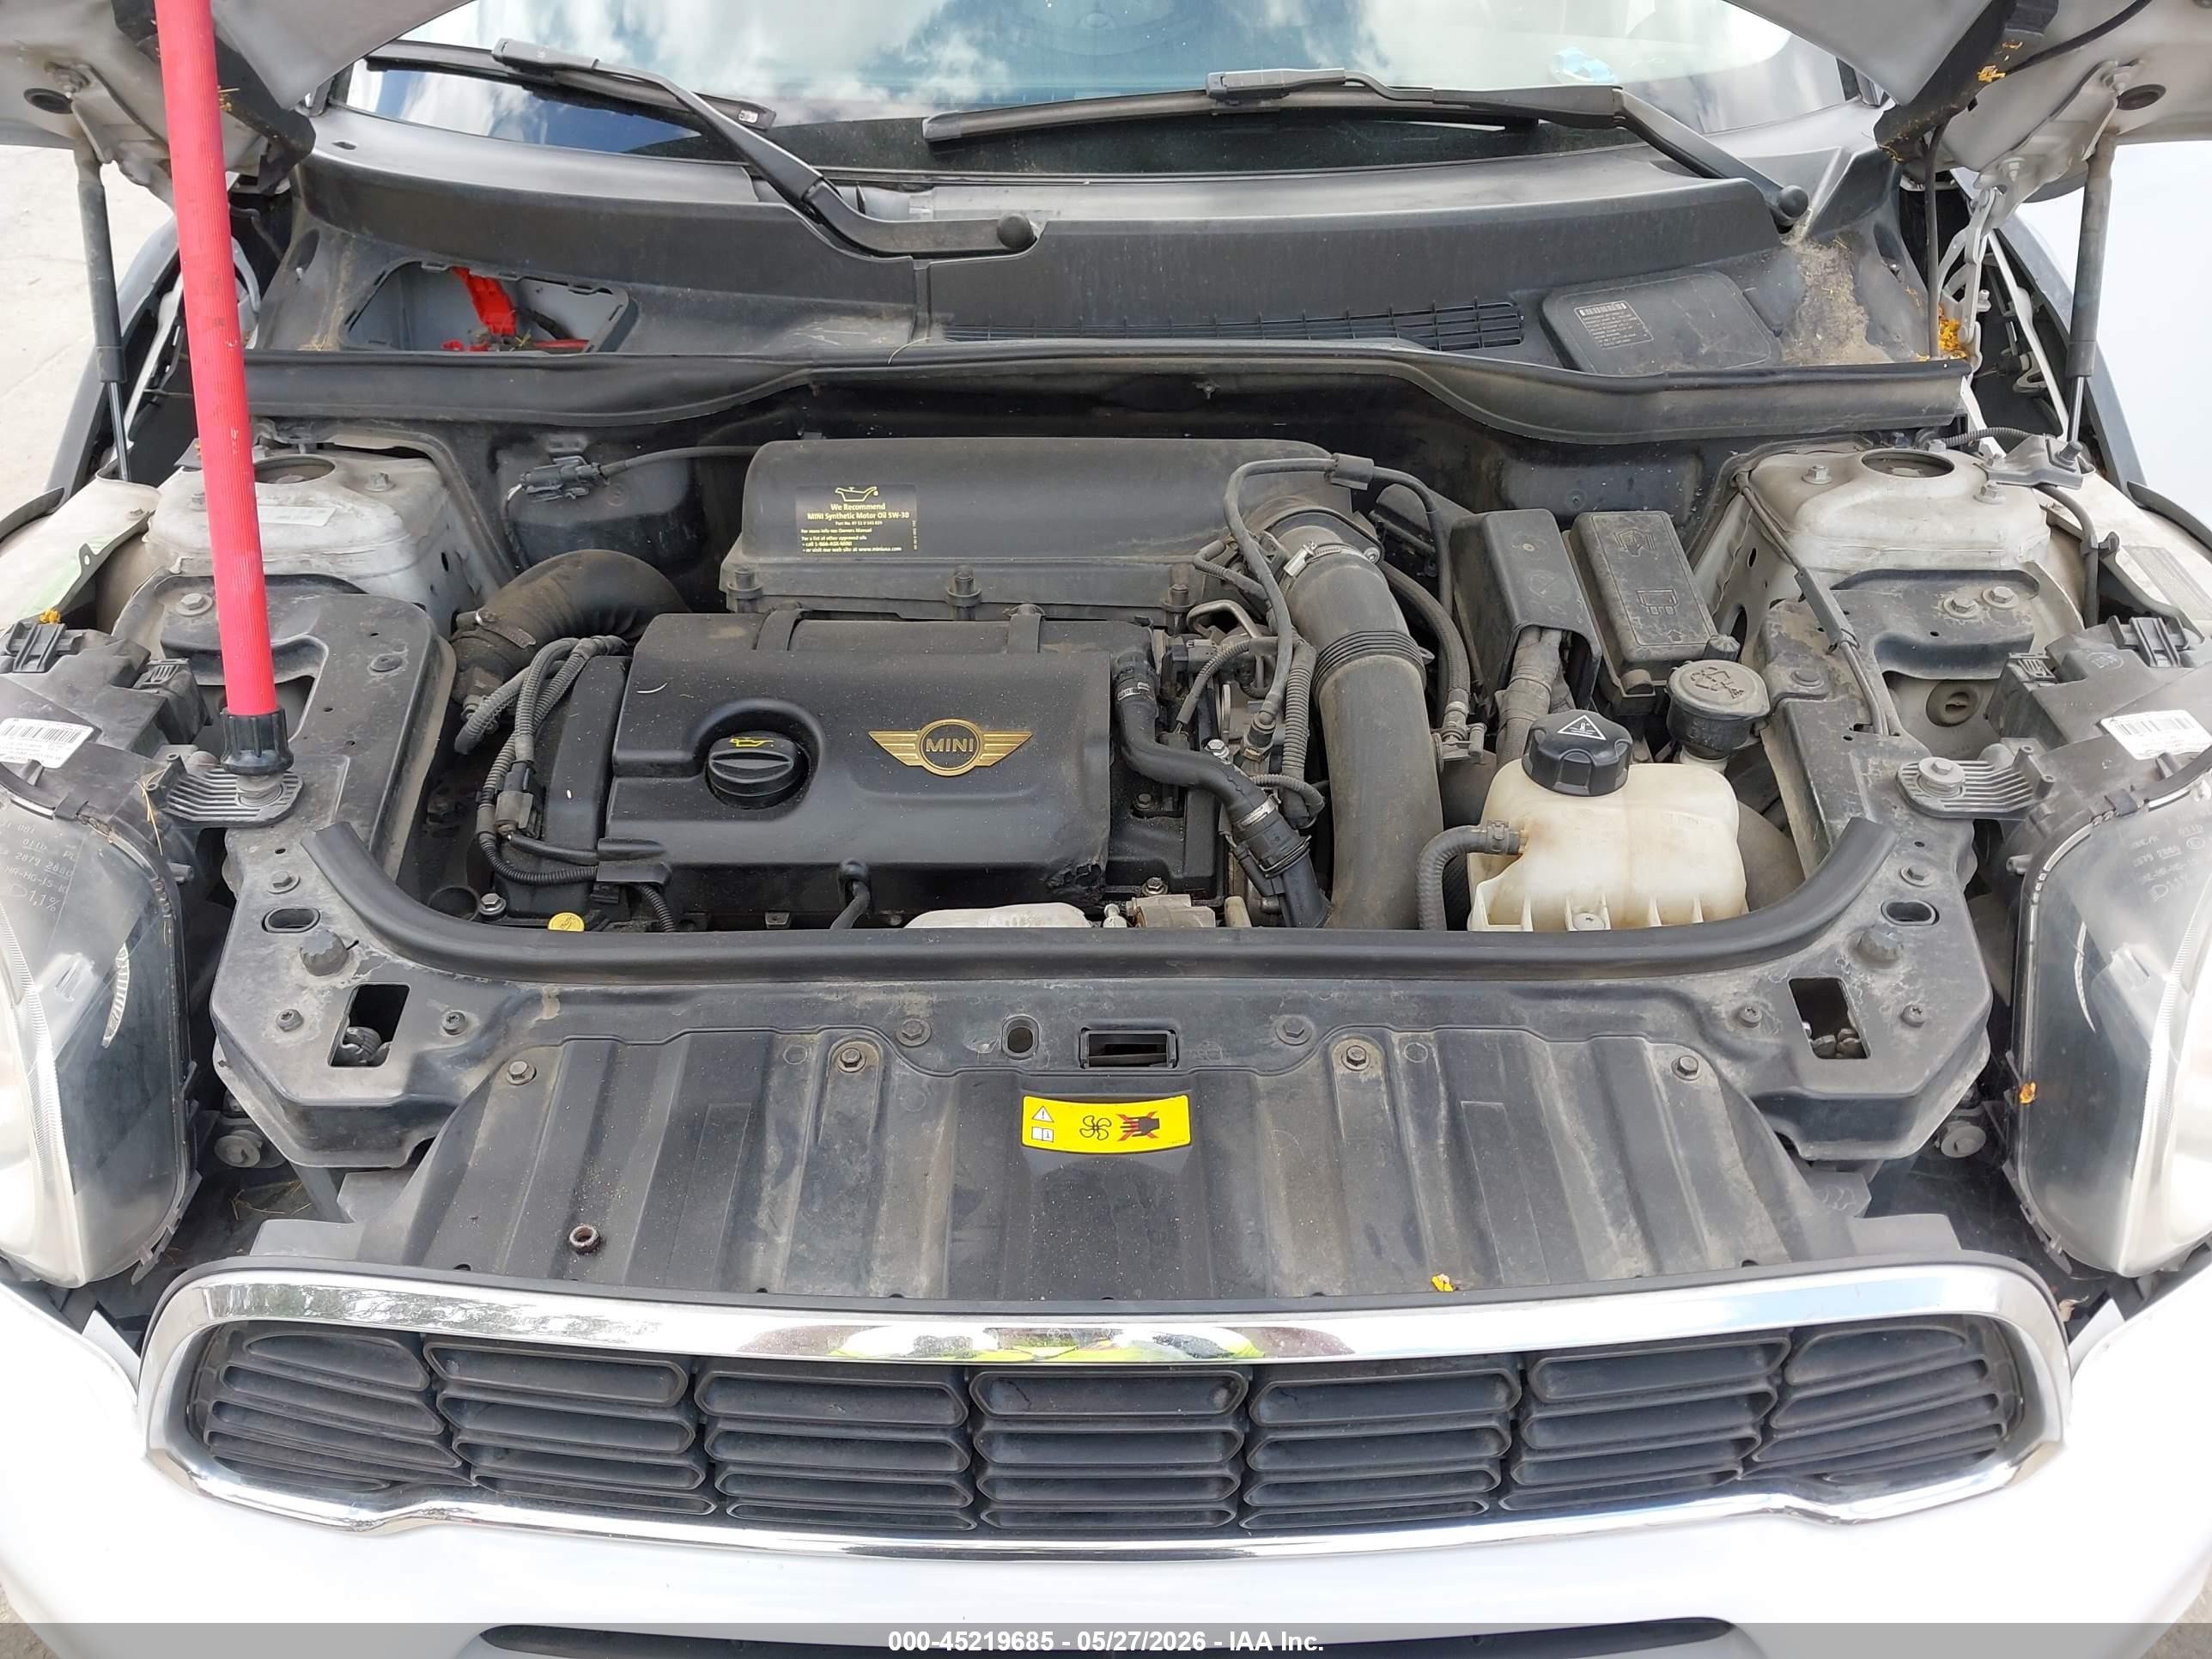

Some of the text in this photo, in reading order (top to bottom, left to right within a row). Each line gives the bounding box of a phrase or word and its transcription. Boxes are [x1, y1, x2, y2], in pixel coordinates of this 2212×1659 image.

[843, 502, 886, 511] Recommend
[824, 513, 855, 521] Synthetic
[926, 738, 974, 752] MINI
